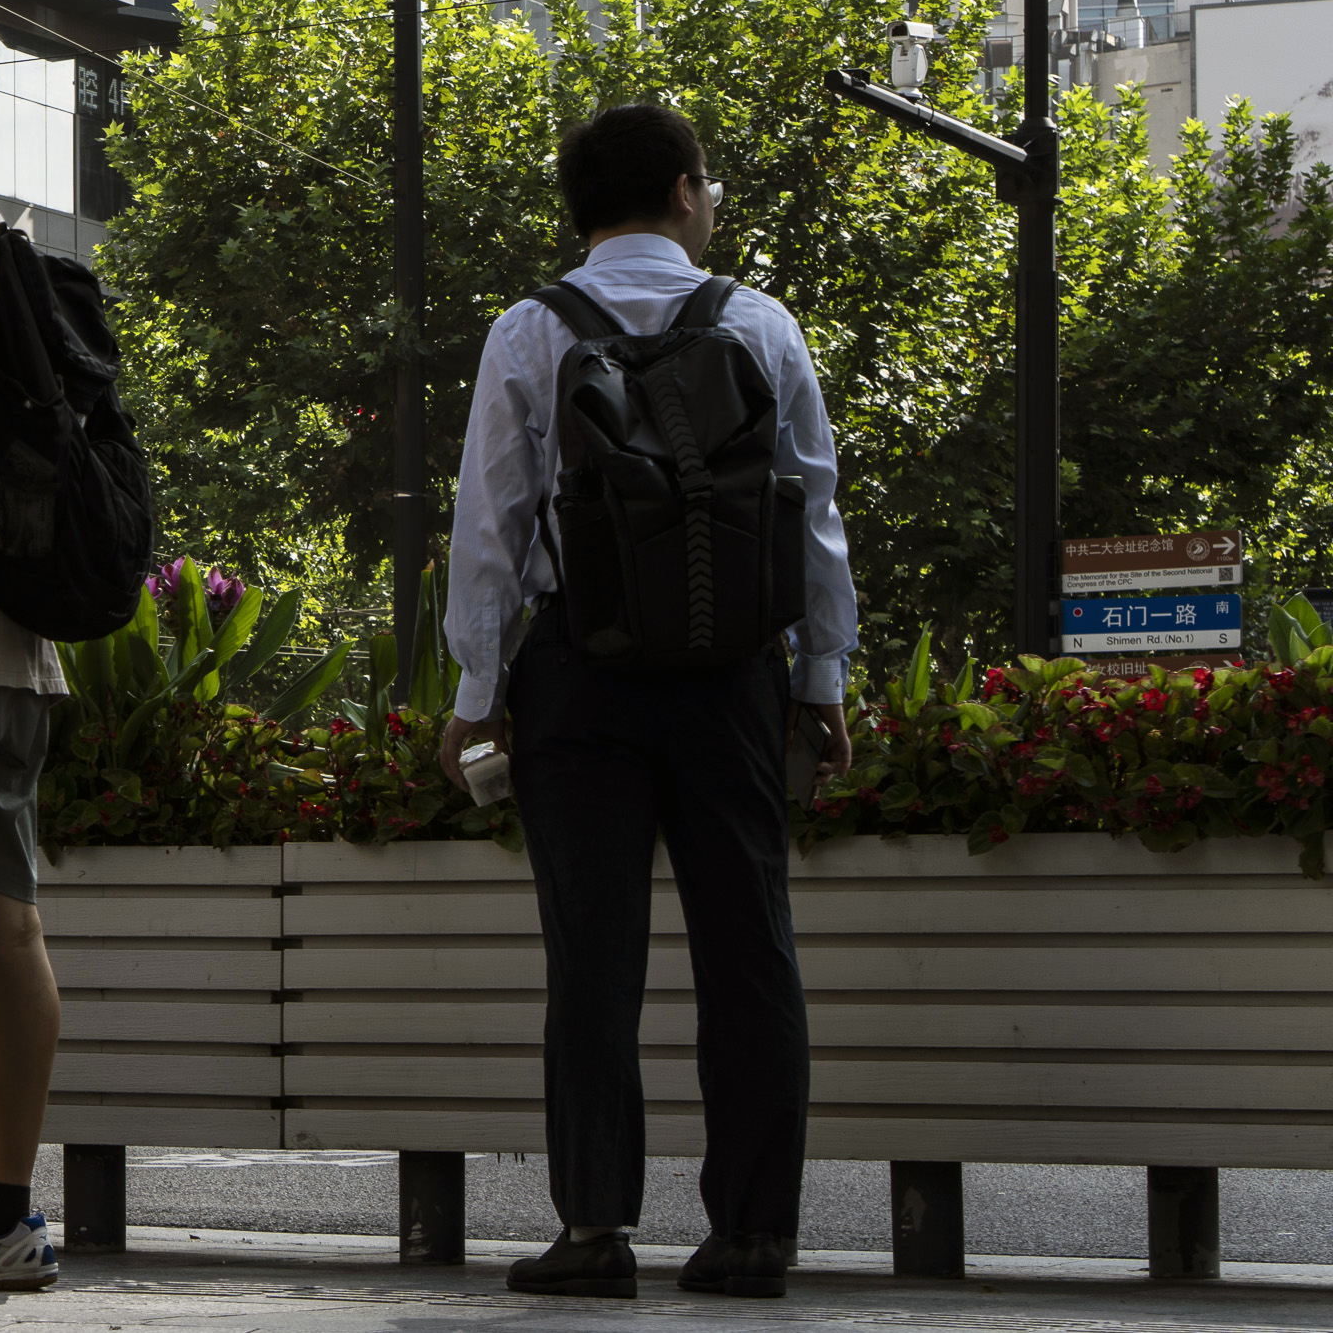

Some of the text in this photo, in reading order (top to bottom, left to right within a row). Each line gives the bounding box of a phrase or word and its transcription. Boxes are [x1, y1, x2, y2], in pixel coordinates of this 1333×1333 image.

[1066, 538, 1174, 557] 中共二大会址纪念馆
[1081, 573, 1108, 581] Memorial
[1102, 601, 1229, 627] 石门一路 南
[1074, 638, 1082, 648] N
[1107, 636, 1141, 645] Shimen
[1219, 633, 1228, 644] S
